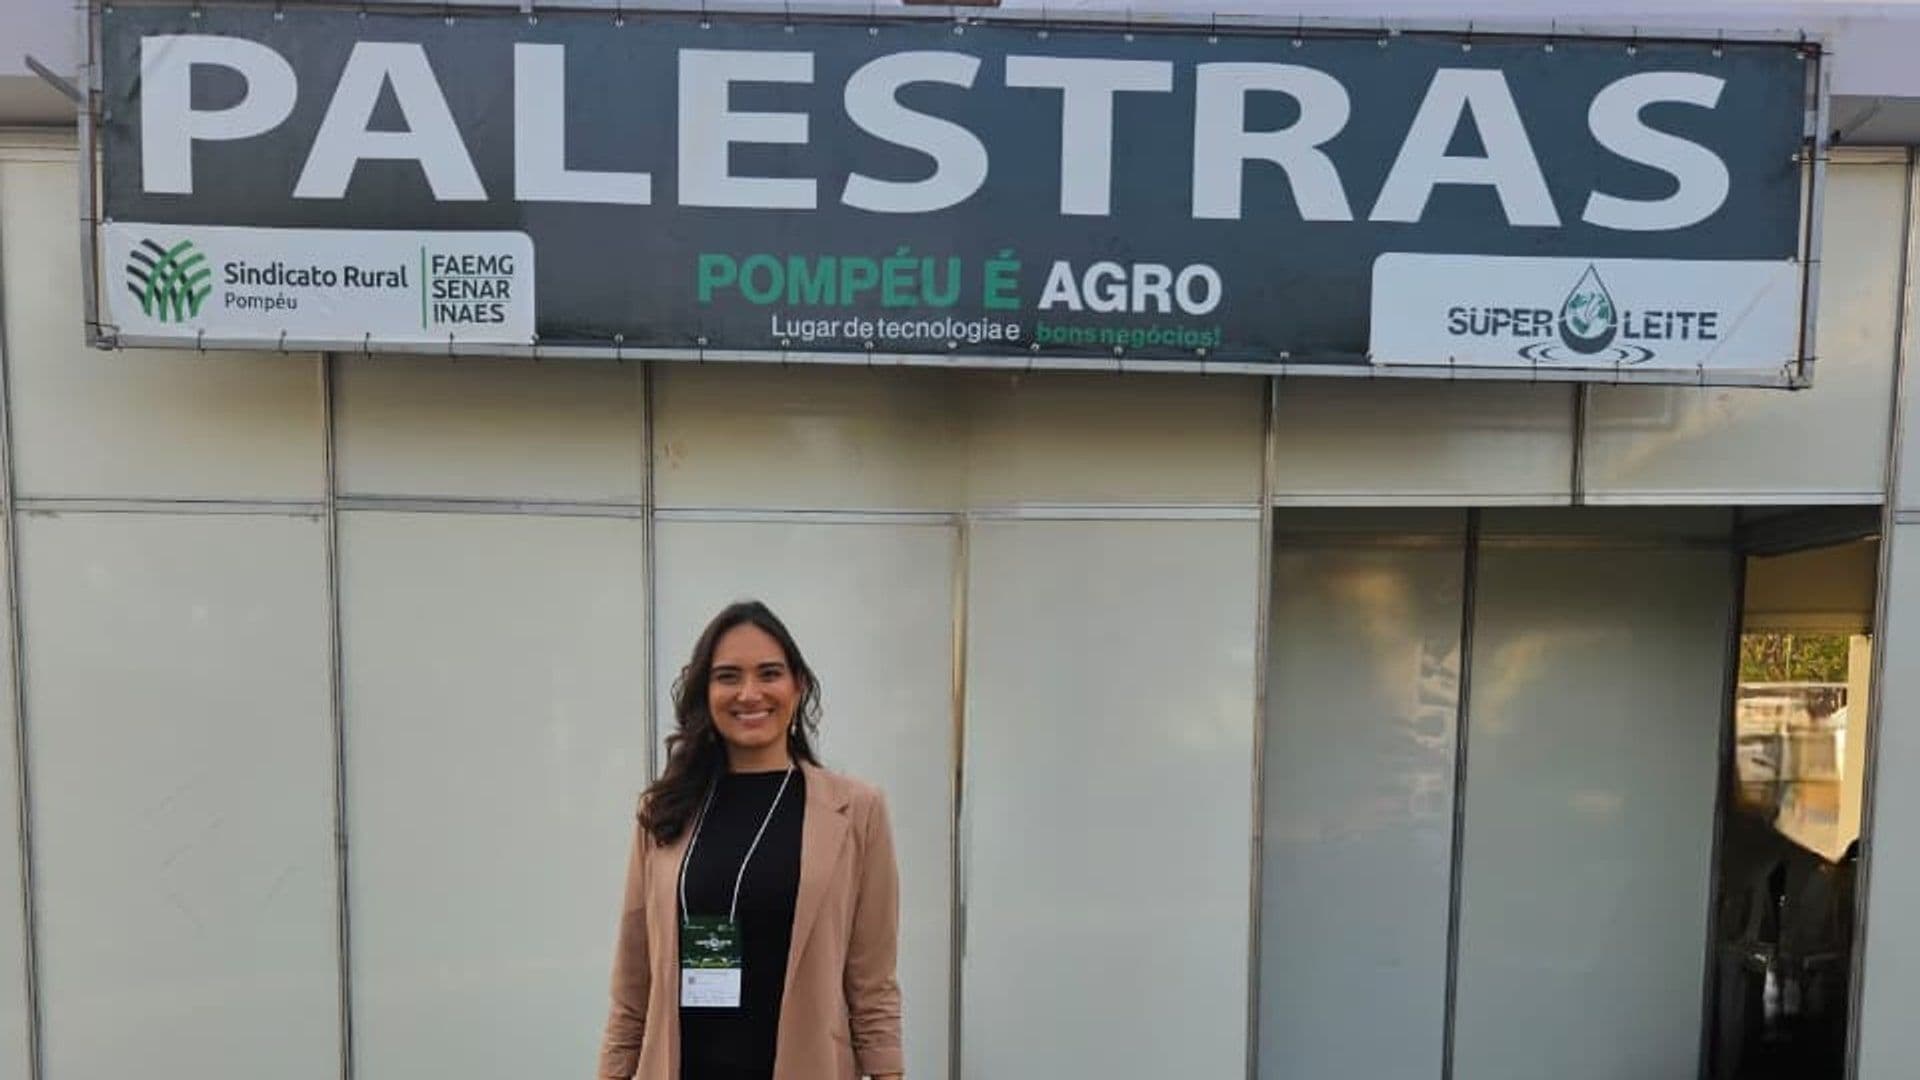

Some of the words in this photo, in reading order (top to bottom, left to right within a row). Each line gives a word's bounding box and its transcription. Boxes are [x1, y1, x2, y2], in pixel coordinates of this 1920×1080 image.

[140, 34, 1731, 231] PALESTRAS
[223, 262, 337, 286] Sindicato
[343, 266, 408, 287] Rural
[432, 255, 514, 275] FAEMG
[432, 279, 511, 299] SENAR
[697, 247, 961, 308] POMPÉU
[984, 249, 1021, 309] É
[1038, 260, 1223, 315] AGRO
[225, 292, 298, 312] Pompéu
[433, 303, 505, 323] INAES
[771, 315, 839, 341] Lugar
[843, 317, 874, 338] de
[878, 317, 1000, 343] tecnologia
[1005, 324, 1020, 340] e
[1447, 307, 1553, 337] SUPER
[1623, 310, 1718, 340] LEITE
[1100, 324, 1221, 348] negócios!
